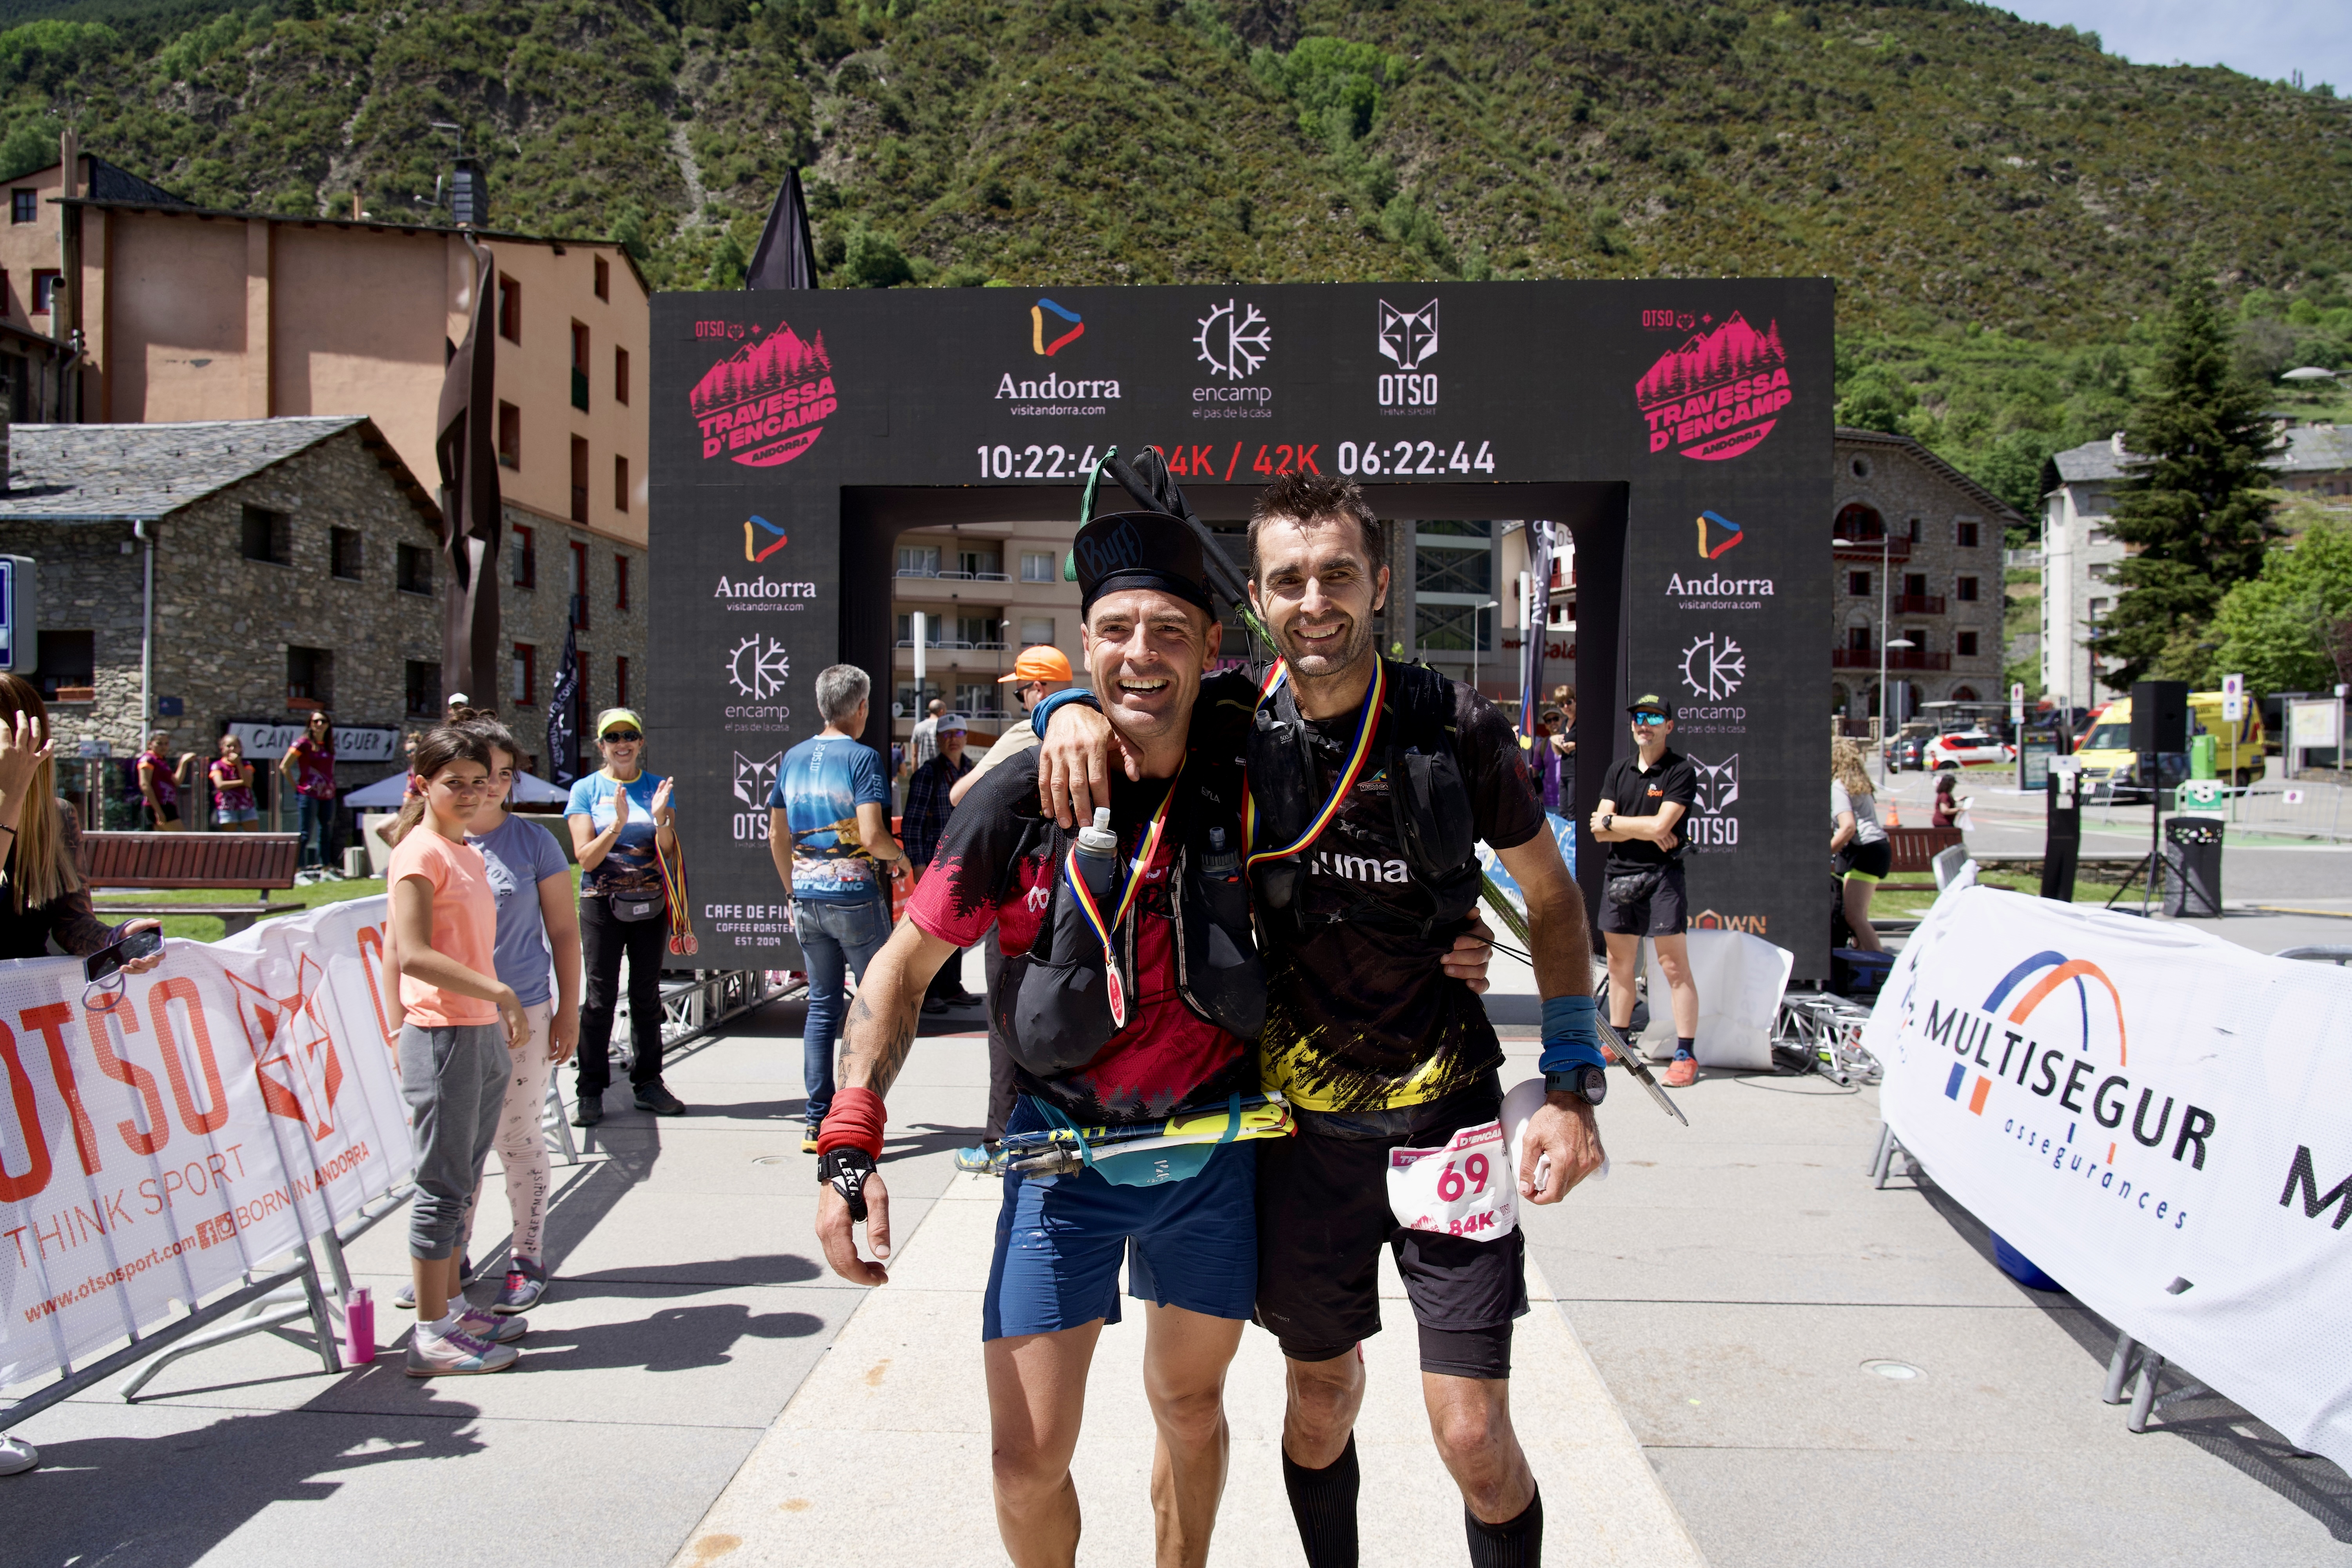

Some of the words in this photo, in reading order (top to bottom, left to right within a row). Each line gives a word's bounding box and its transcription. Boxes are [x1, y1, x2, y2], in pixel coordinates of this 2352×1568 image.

[695, 320, 725, 338] OTSO
[1642, 310, 1673, 327] OTSO
[995, 372, 1121, 399] Andorra
[1192, 387, 1272, 406] encamp
[1379, 374, 1438, 406] OTSO
[698, 376, 836, 438] TRAVESSA
[1010, 404, 1106, 416] visitandorra.com
[1644, 367, 1790, 431] TRAVESSA
[1192, 407, 1201, 418] el
[1204, 410, 1221, 421] pas
[1223, 407, 1237, 418] de
[1239, 406, 1248, 418] la
[1249, 410, 1272, 418] casa
[1650, 388, 1792, 454] D'ENCAMP
[703, 397, 838, 459] D'ENCAMP
[751, 436, 809, 463] ANDORRA
[1701, 429, 1762, 456] ANDORRA
[1152, 445, 1214, 476] 4K
[1225, 441, 1243, 481] /
[1253, 444, 1320, 475] 42K
[1338, 441, 1495, 475] 06:22:44
[714, 575, 817, 598] Andorra
[1665, 572, 1775, 595] Andorra
[726, 602, 804, 611] visitandorra.com
[1679, 600, 1761, 610] visitandorra.com
[725, 706, 790, 723] encamp
[1677, 707, 1746, 724] encamp
[252, 729, 294, 749] CAN
[725, 723, 733, 731] el
[735, 724, 748, 733] pas
[750, 723, 762, 731] de
[763, 722, 770, 731] la
[1677, 724, 1685, 733] el
[1688, 726, 1703, 735] pas
[1705, 724, 1717, 733] de
[1718, 724, 1725, 733] la
[809, 752, 824, 773] OTSO
[872, 774, 883, 799] OTSO
[734, 813, 768, 840] OTS
[1687, 817, 1738, 844] OTSO
[705, 904, 742, 918] CAFE
[747, 905, 764, 918] DE
[769, 905, 790, 919] FIN
[716, 923, 751, 932] COFFEE
[757, 937, 780, 946] 2009
[1924, 1000, 2216, 1171] MULTISEGUR
[1460, 1127, 1502, 1147] D'ENCAM
[837, 1158, 859, 1191] LEKI
[1437, 1153, 1489, 1202] 69
[2004, 1119, 2186, 1229] assegurances
[4, 1189, 134, 1268] THINK
[139, 1143, 245, 1215] SPORT
[24, 1236, 196, 1323] www.otsosport.com
[236, 1186, 291, 1230] BORN
[290, 1175, 312, 1201] IN
[314, 1141, 370, 1191] ANDORRA
[1448, 1210, 1495, 1236] 84K
